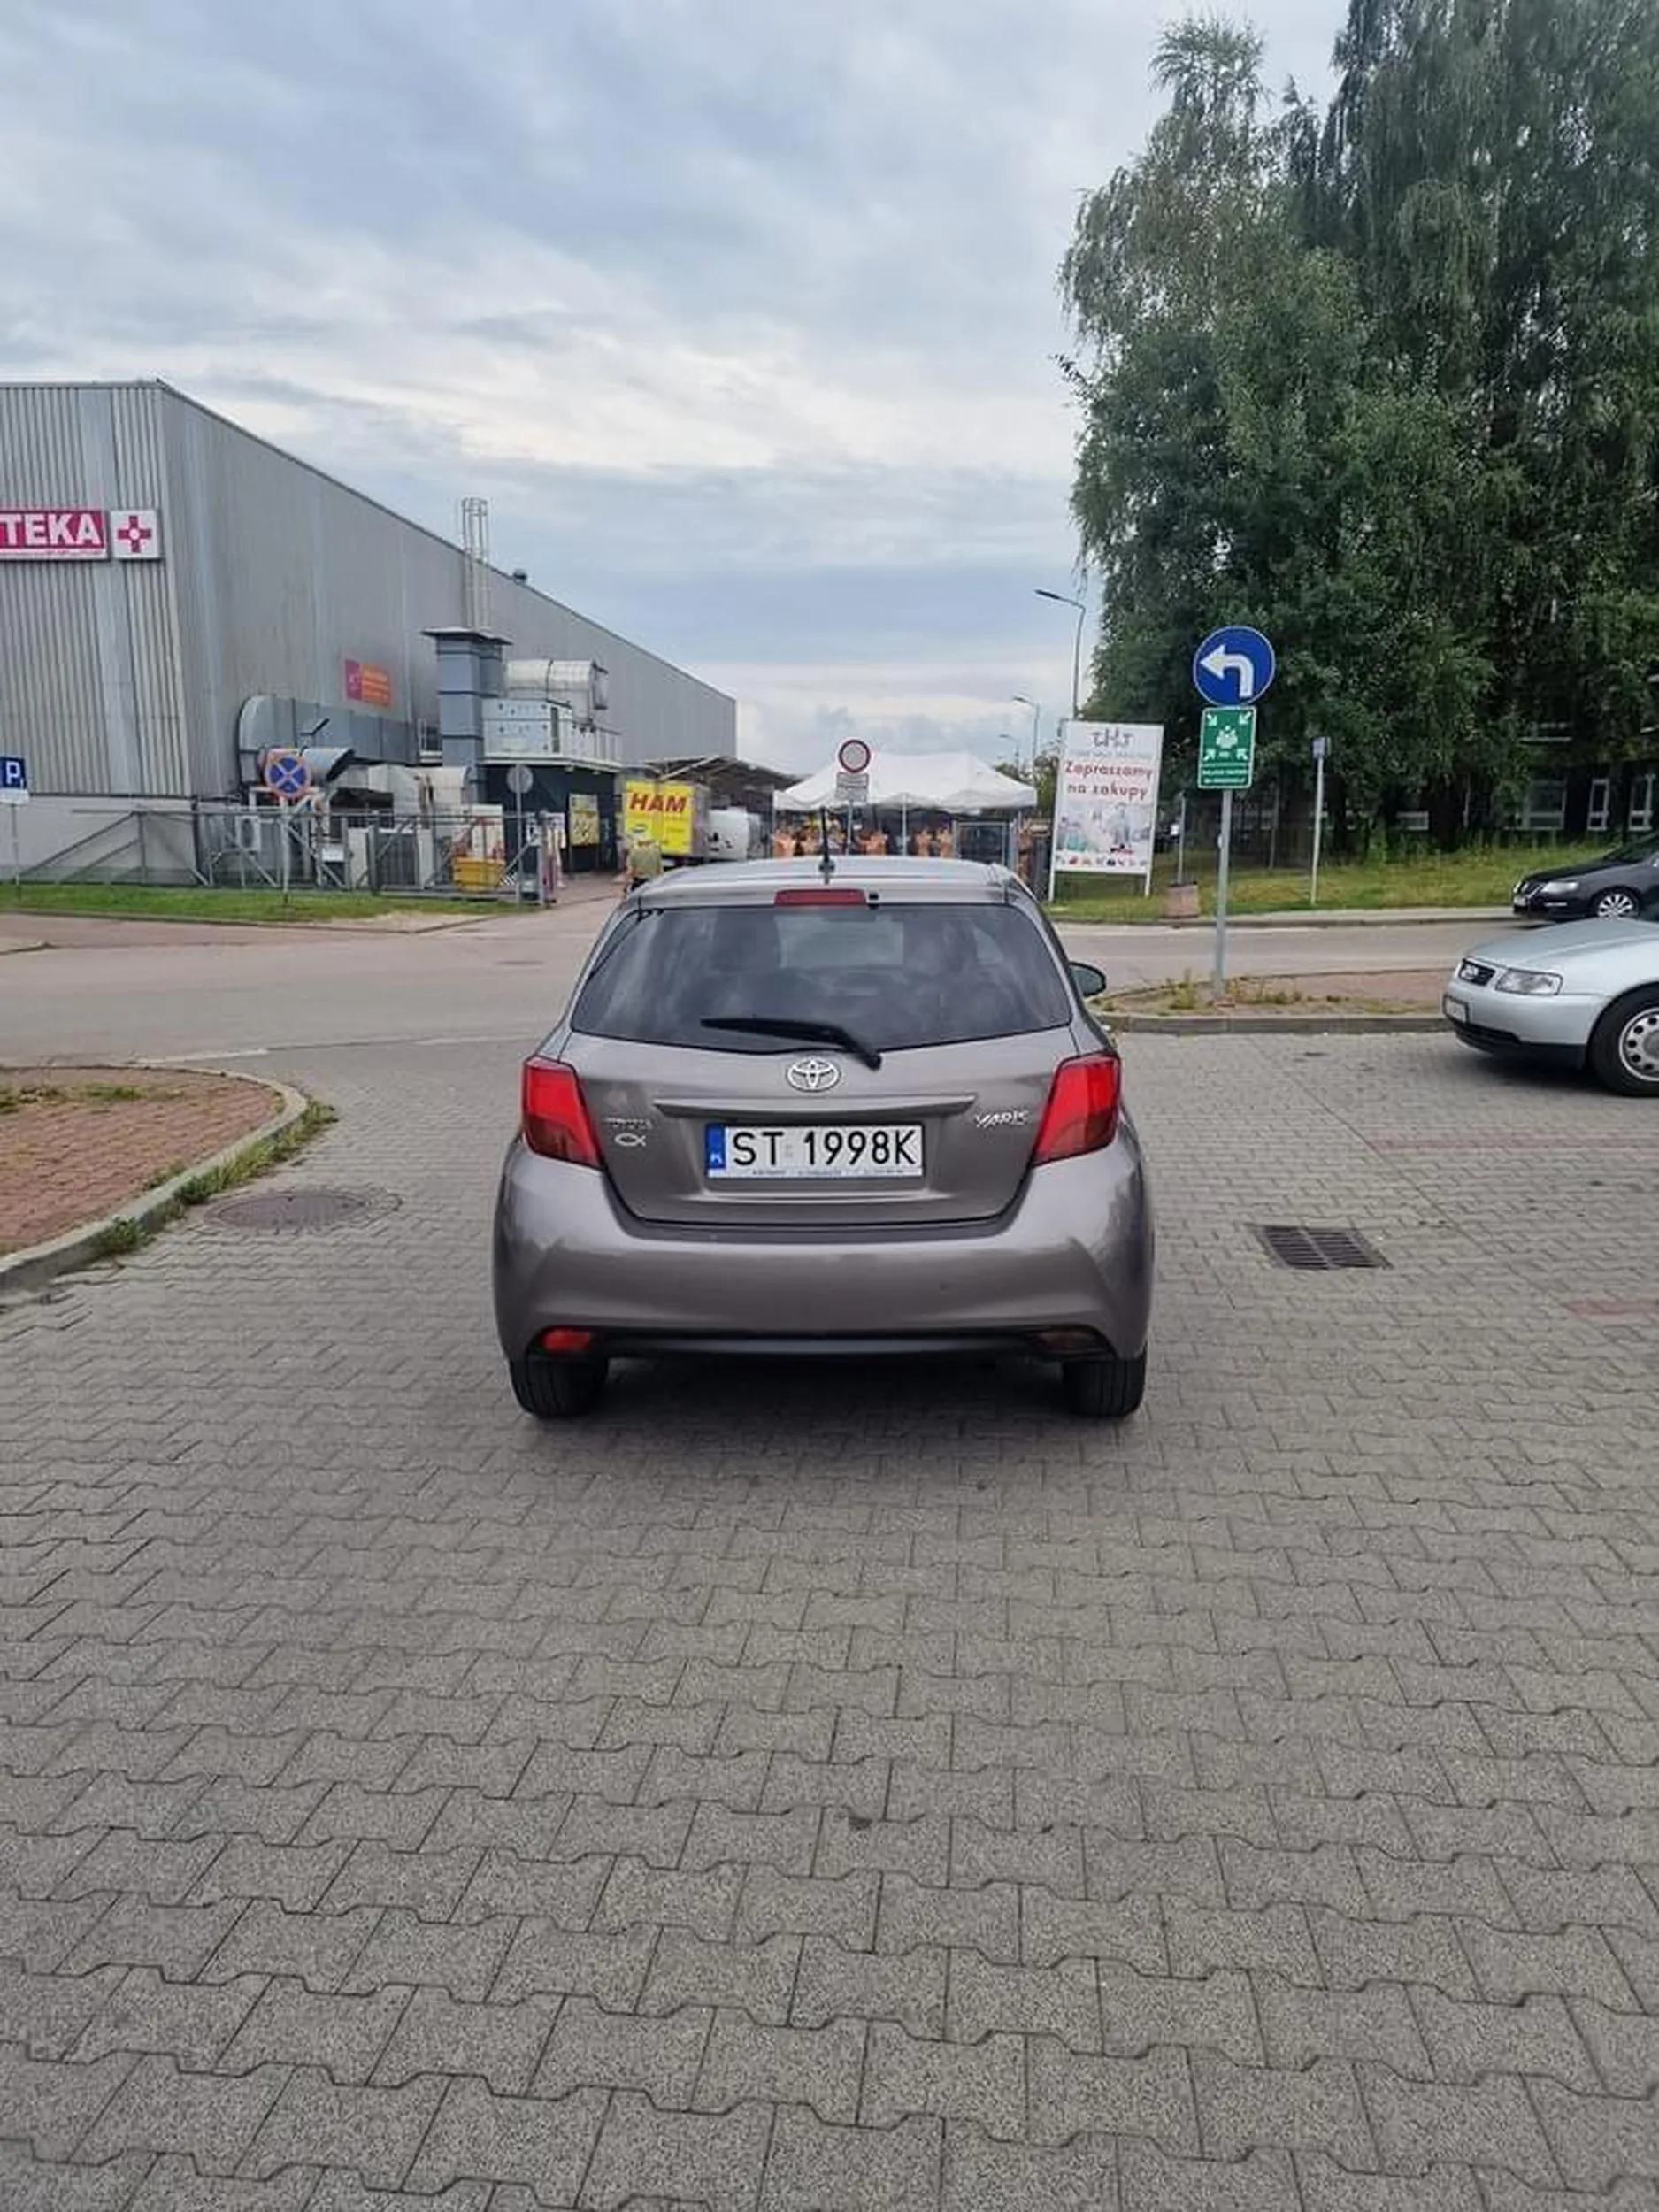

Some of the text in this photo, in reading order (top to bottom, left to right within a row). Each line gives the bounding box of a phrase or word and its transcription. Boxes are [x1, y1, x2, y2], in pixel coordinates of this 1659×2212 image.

[0, 513, 102, 545] TEKA
[6, 761, 21, 785] P
[1065, 761, 1151, 781] Zapraszamy
[1068, 780, 1148, 801] na zakupy
[733, 1130, 915, 1165] ST 1998K
